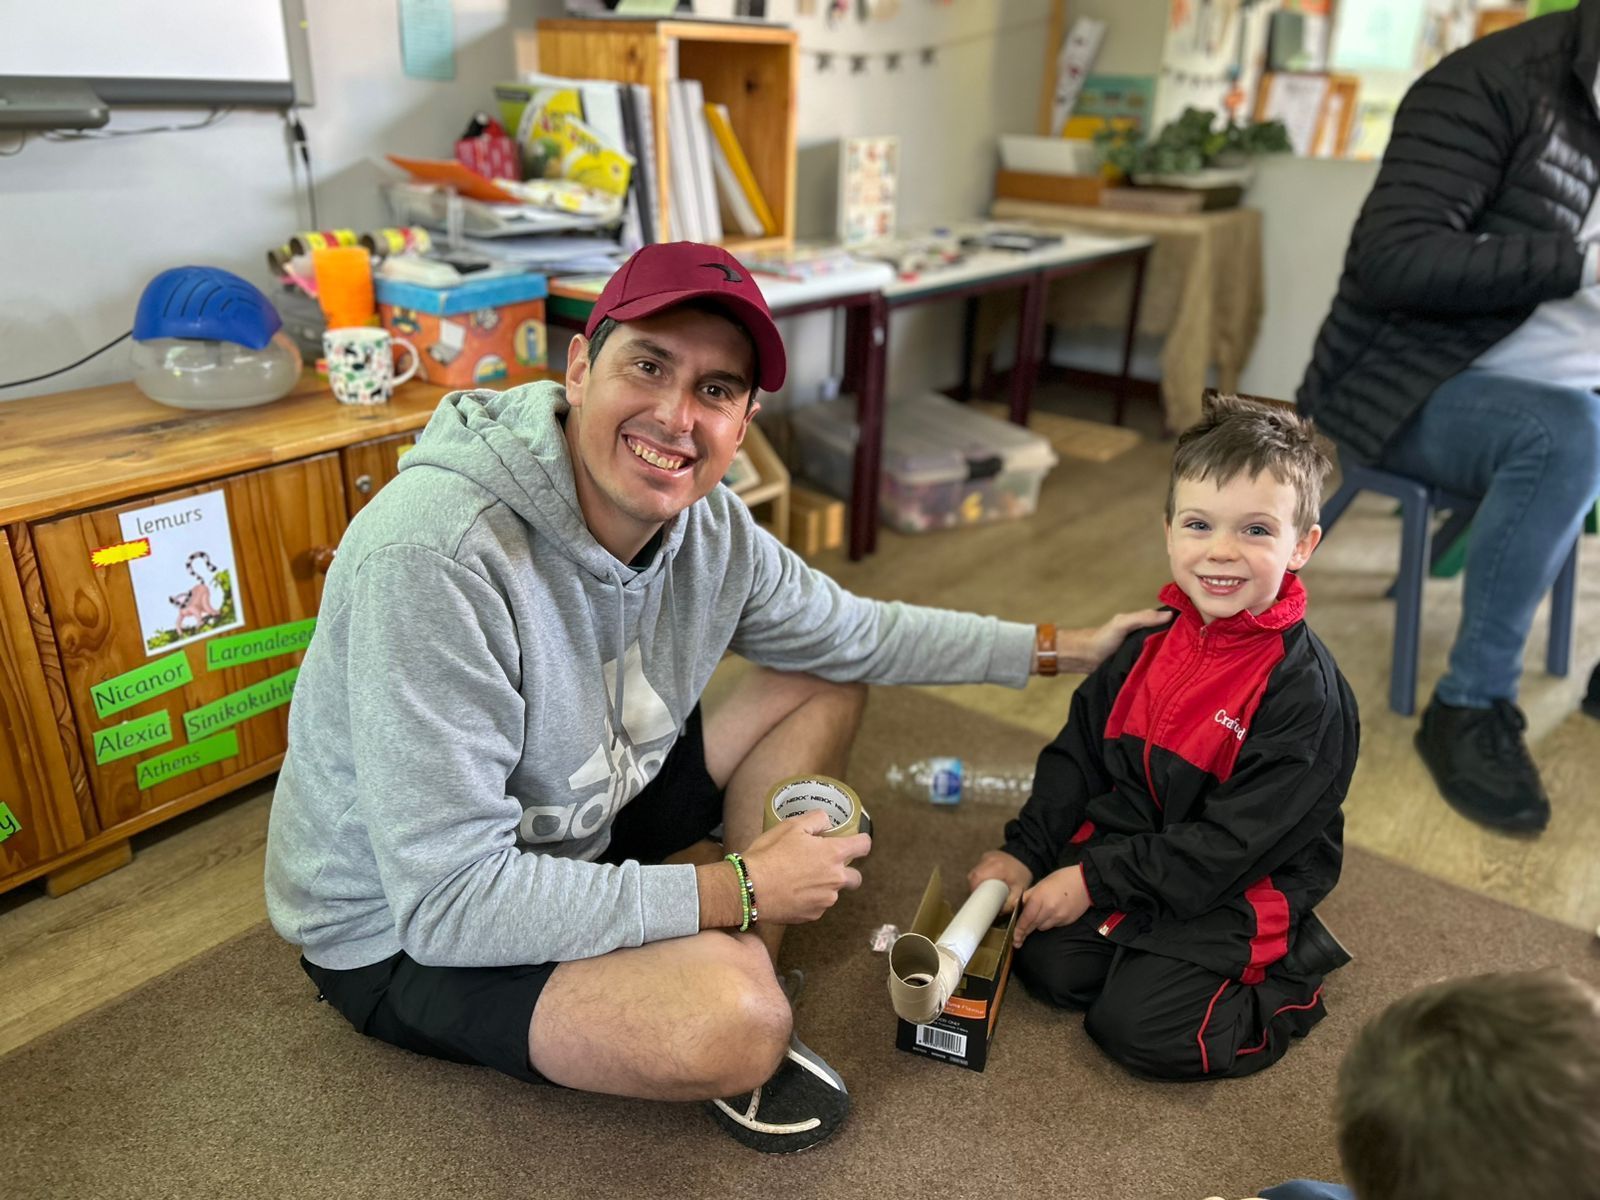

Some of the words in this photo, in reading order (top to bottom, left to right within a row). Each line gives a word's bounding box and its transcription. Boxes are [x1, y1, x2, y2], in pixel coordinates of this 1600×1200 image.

[136, 508, 203, 535] lemurs
[96, 663, 184, 710] Nicanor
[98, 722, 168, 757] Alexia
[140, 750, 200, 783] Athens
[786, 796, 807, 804] NEXX
[810, 795, 832, 805] NEXX
